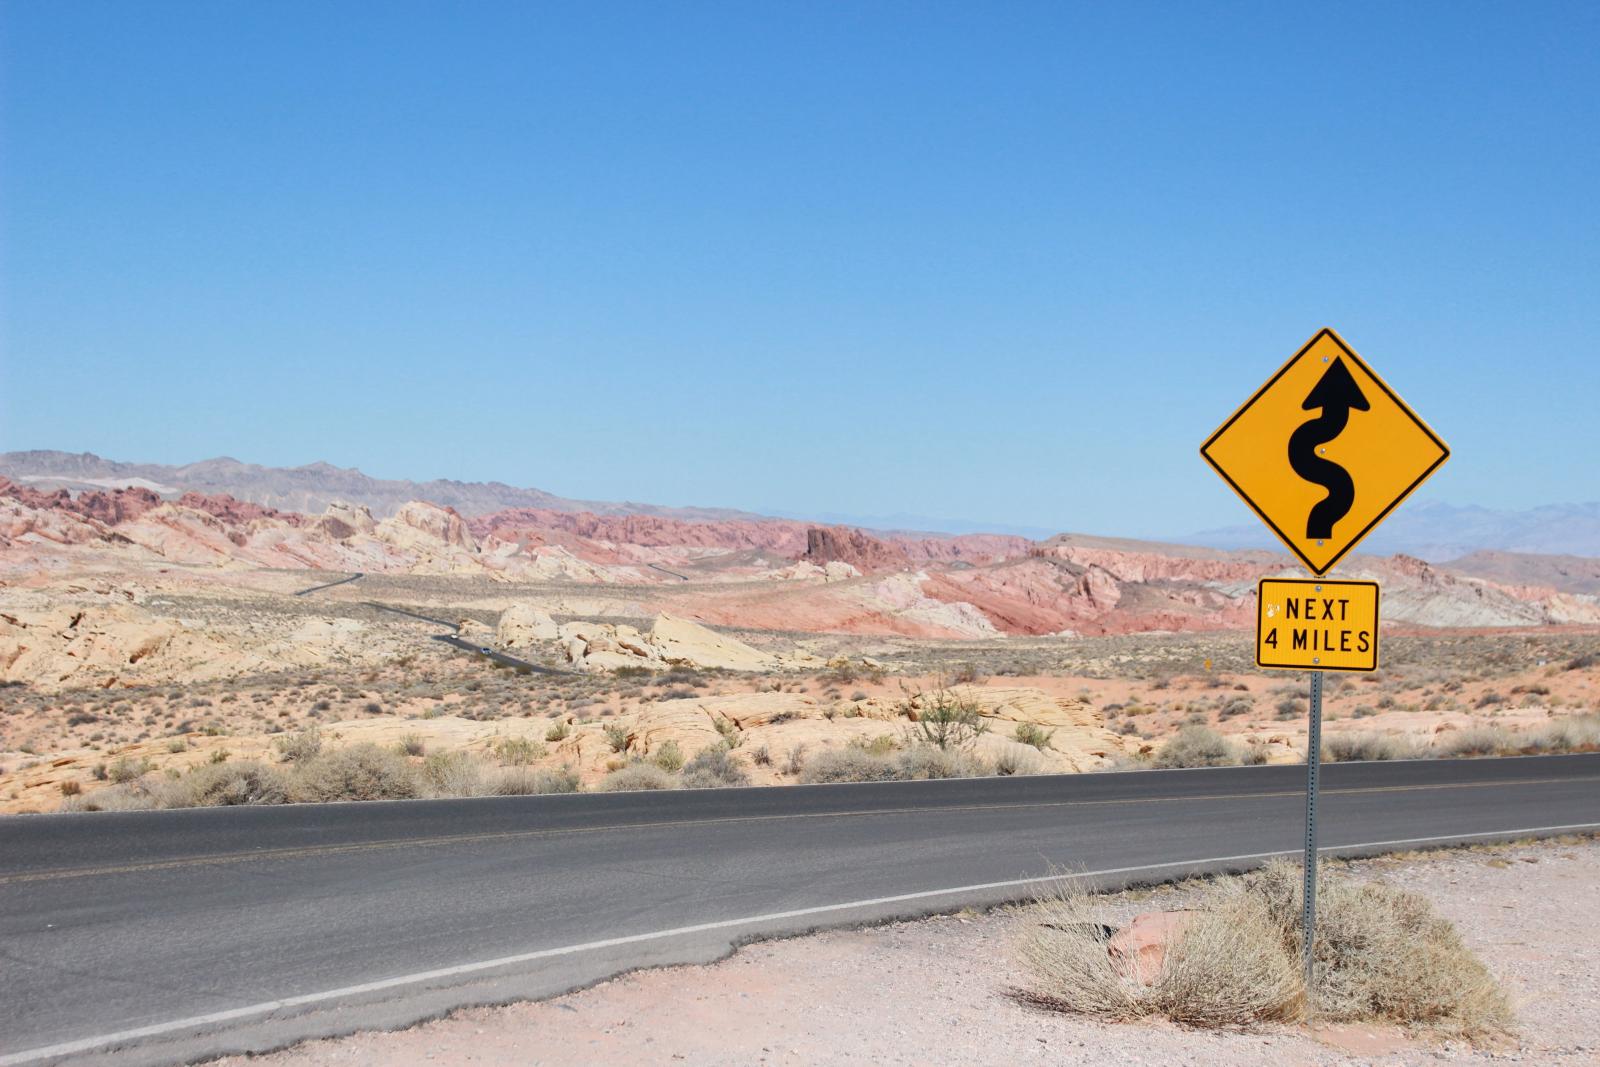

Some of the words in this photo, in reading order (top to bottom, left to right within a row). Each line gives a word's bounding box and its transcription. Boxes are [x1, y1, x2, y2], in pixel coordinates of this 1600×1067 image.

[1286, 598, 1349, 620] NEXT
[1265, 628, 1277, 649] 4
[1293, 629, 1369, 652] MILES
